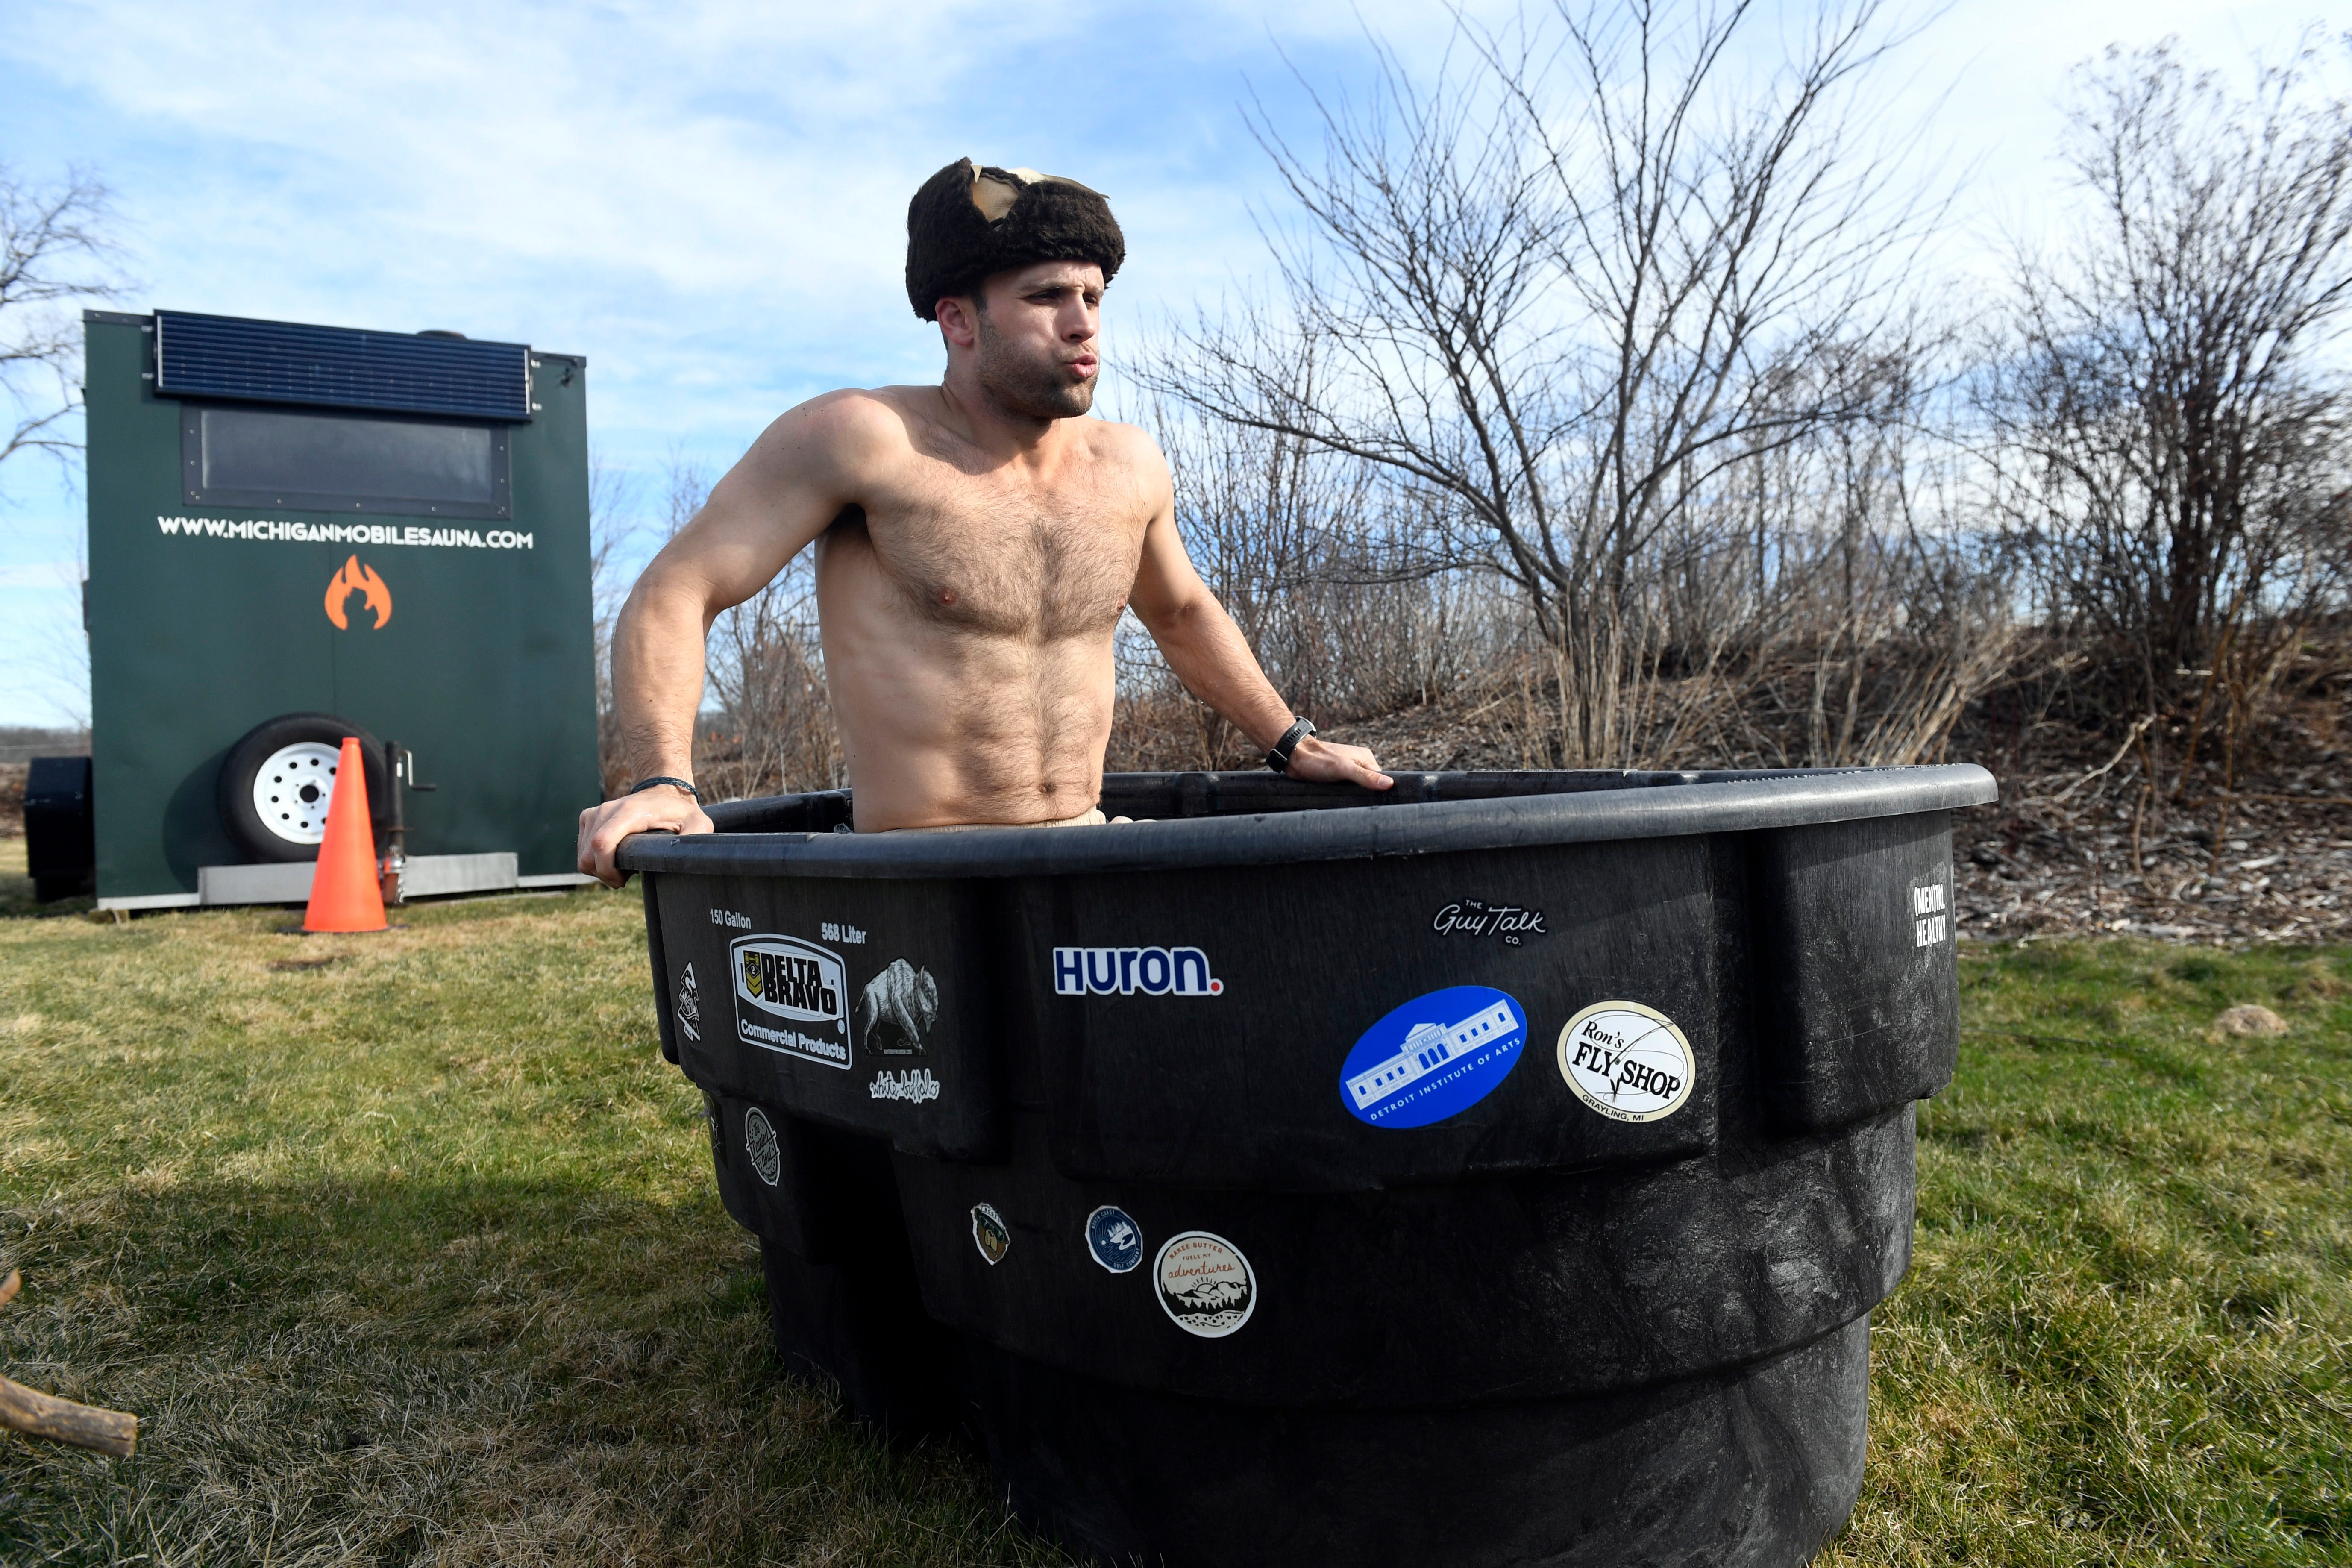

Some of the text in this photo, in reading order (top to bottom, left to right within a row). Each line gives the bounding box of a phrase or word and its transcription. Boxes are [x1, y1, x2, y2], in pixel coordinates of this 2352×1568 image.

[157, 516, 533, 549] WWW.MICHIGANMOBILESAUNA.COM
[1465, 899, 1483, 909] THE
[710, 908, 752, 929] 150 Gallon
[1433, 904, 1546, 936] Guy Talk
[1916, 914, 1946, 947] HEALTHY
[821, 922, 867, 944] 568 Liter
[1505, 935, 1521, 945] CO.
[751, 966, 755, 975] 2
[761, 952, 822, 988] DELTA
[764, 980, 837, 1015] BRAVO
[741, 1019, 846, 1060] Commercial Products
[1581, 1021, 1624, 1048] Ron's
[1370, 1038, 1521, 1121] DETROIT INSTITUTE OF ARTS
[1572, 1041, 1680, 1100] FLY SHOP
[871, 1070, 938, 1101] white buffalo
[1582, 1094, 1629, 1122] GRAYLING,
[1091, 1216, 1101, 1230] NORTH
[1126, 1248, 1140, 1267] COMPANY
[1193, 1242, 1222, 1254] BUTTER
[1168, 1261, 1236, 1278] adventures
